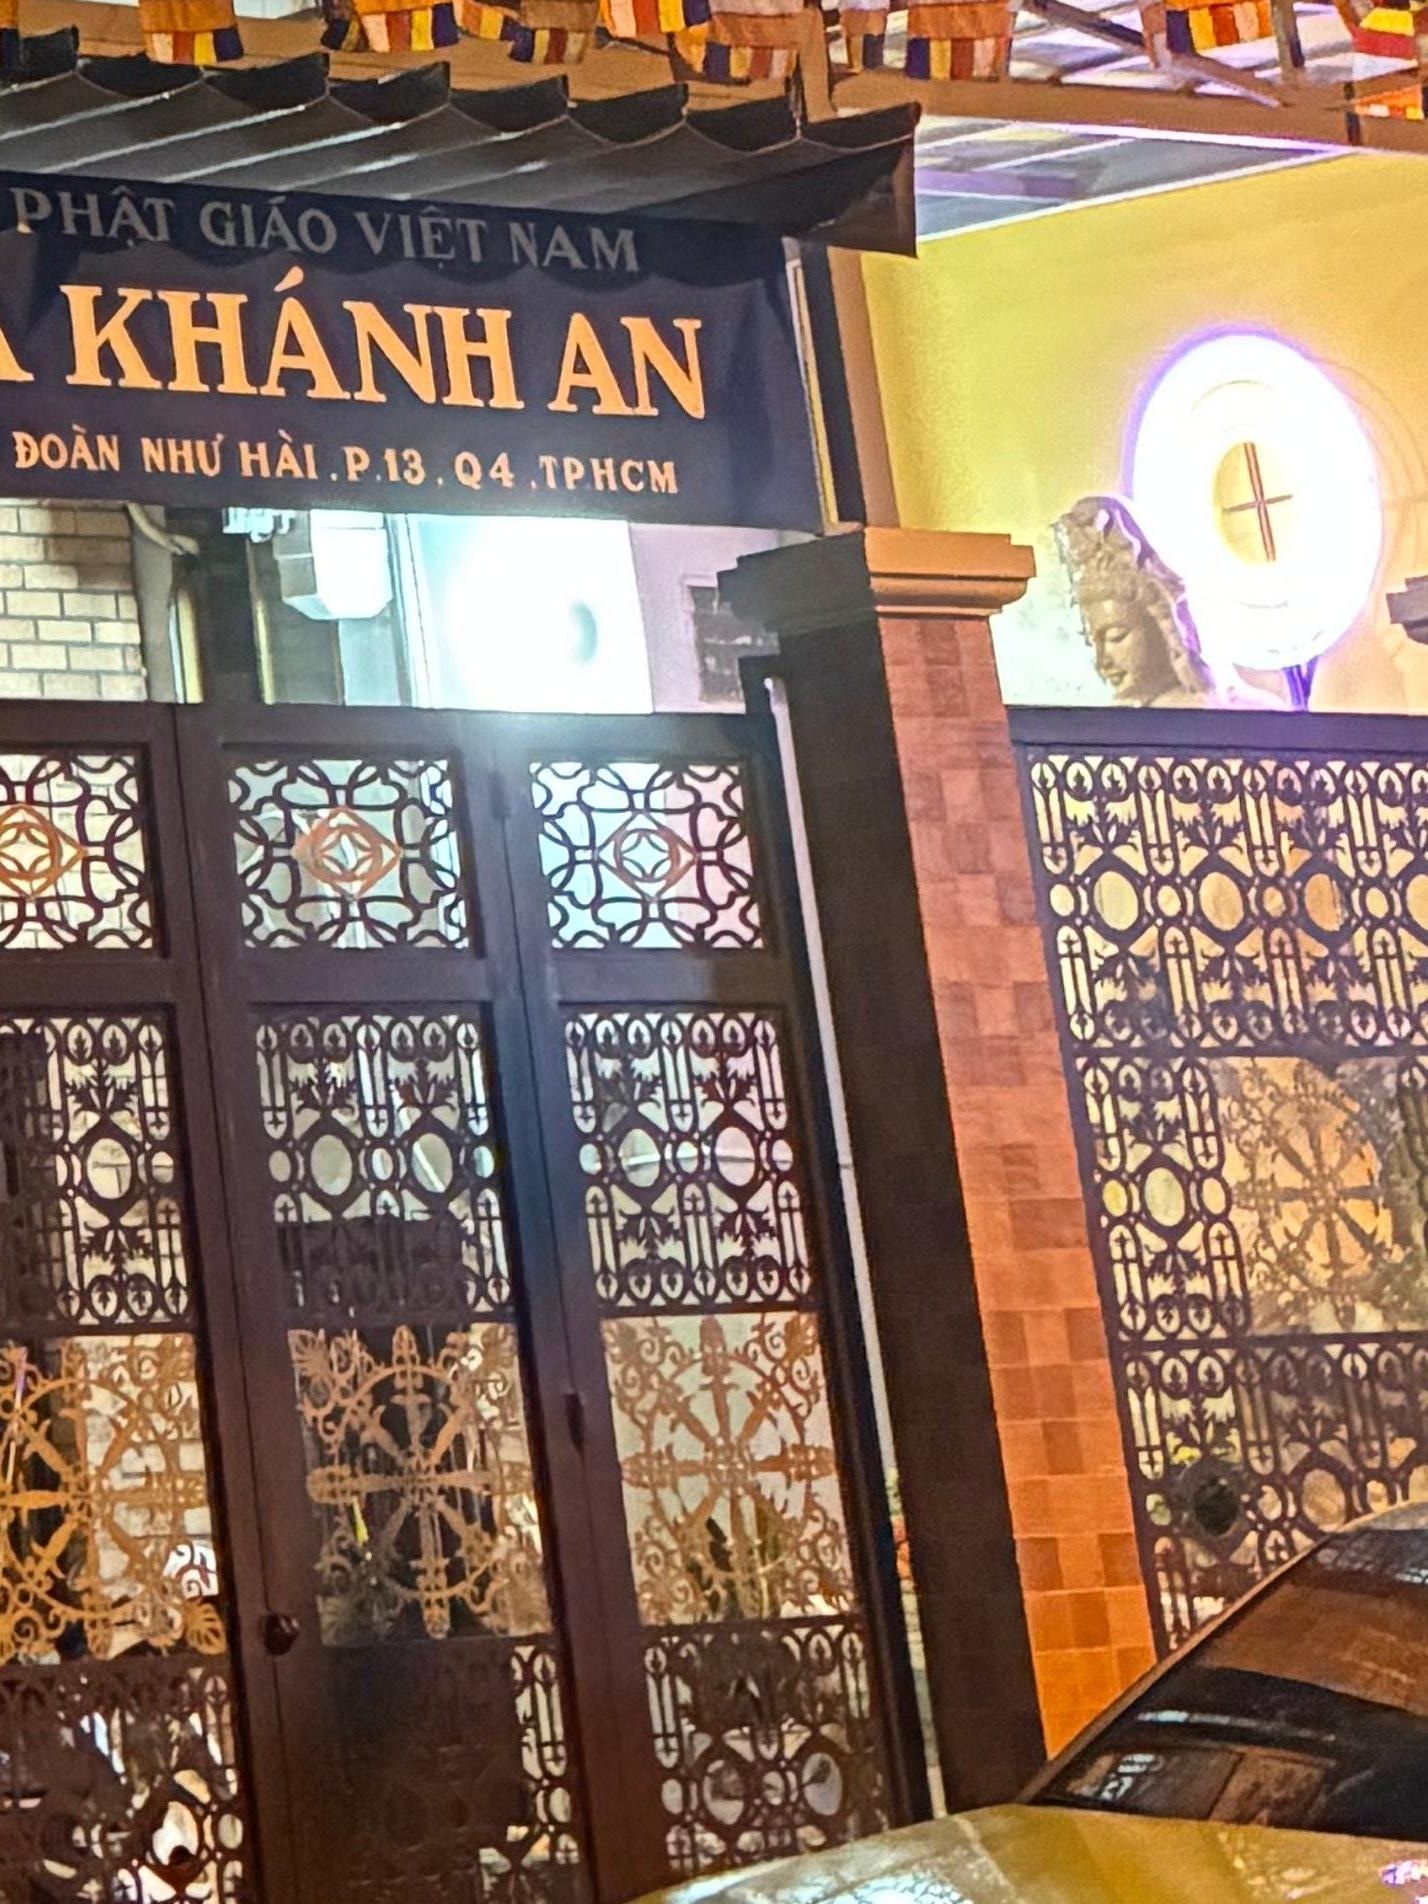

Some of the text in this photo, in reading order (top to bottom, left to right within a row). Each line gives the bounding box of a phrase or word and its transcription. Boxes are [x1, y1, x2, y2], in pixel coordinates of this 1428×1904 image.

[9, 185, 177, 248] PHẬT
[198, 195, 338, 255] GIÁO
[354, 205, 487, 269] VIỆT
[507, 220, 641, 273] NAM
[58, 265, 525, 410] KHÁNH
[547, 311, 706, 420] AN
[11, 423, 121, 473] ĐOÀN
[140, 433, 225, 478] NHƯ
